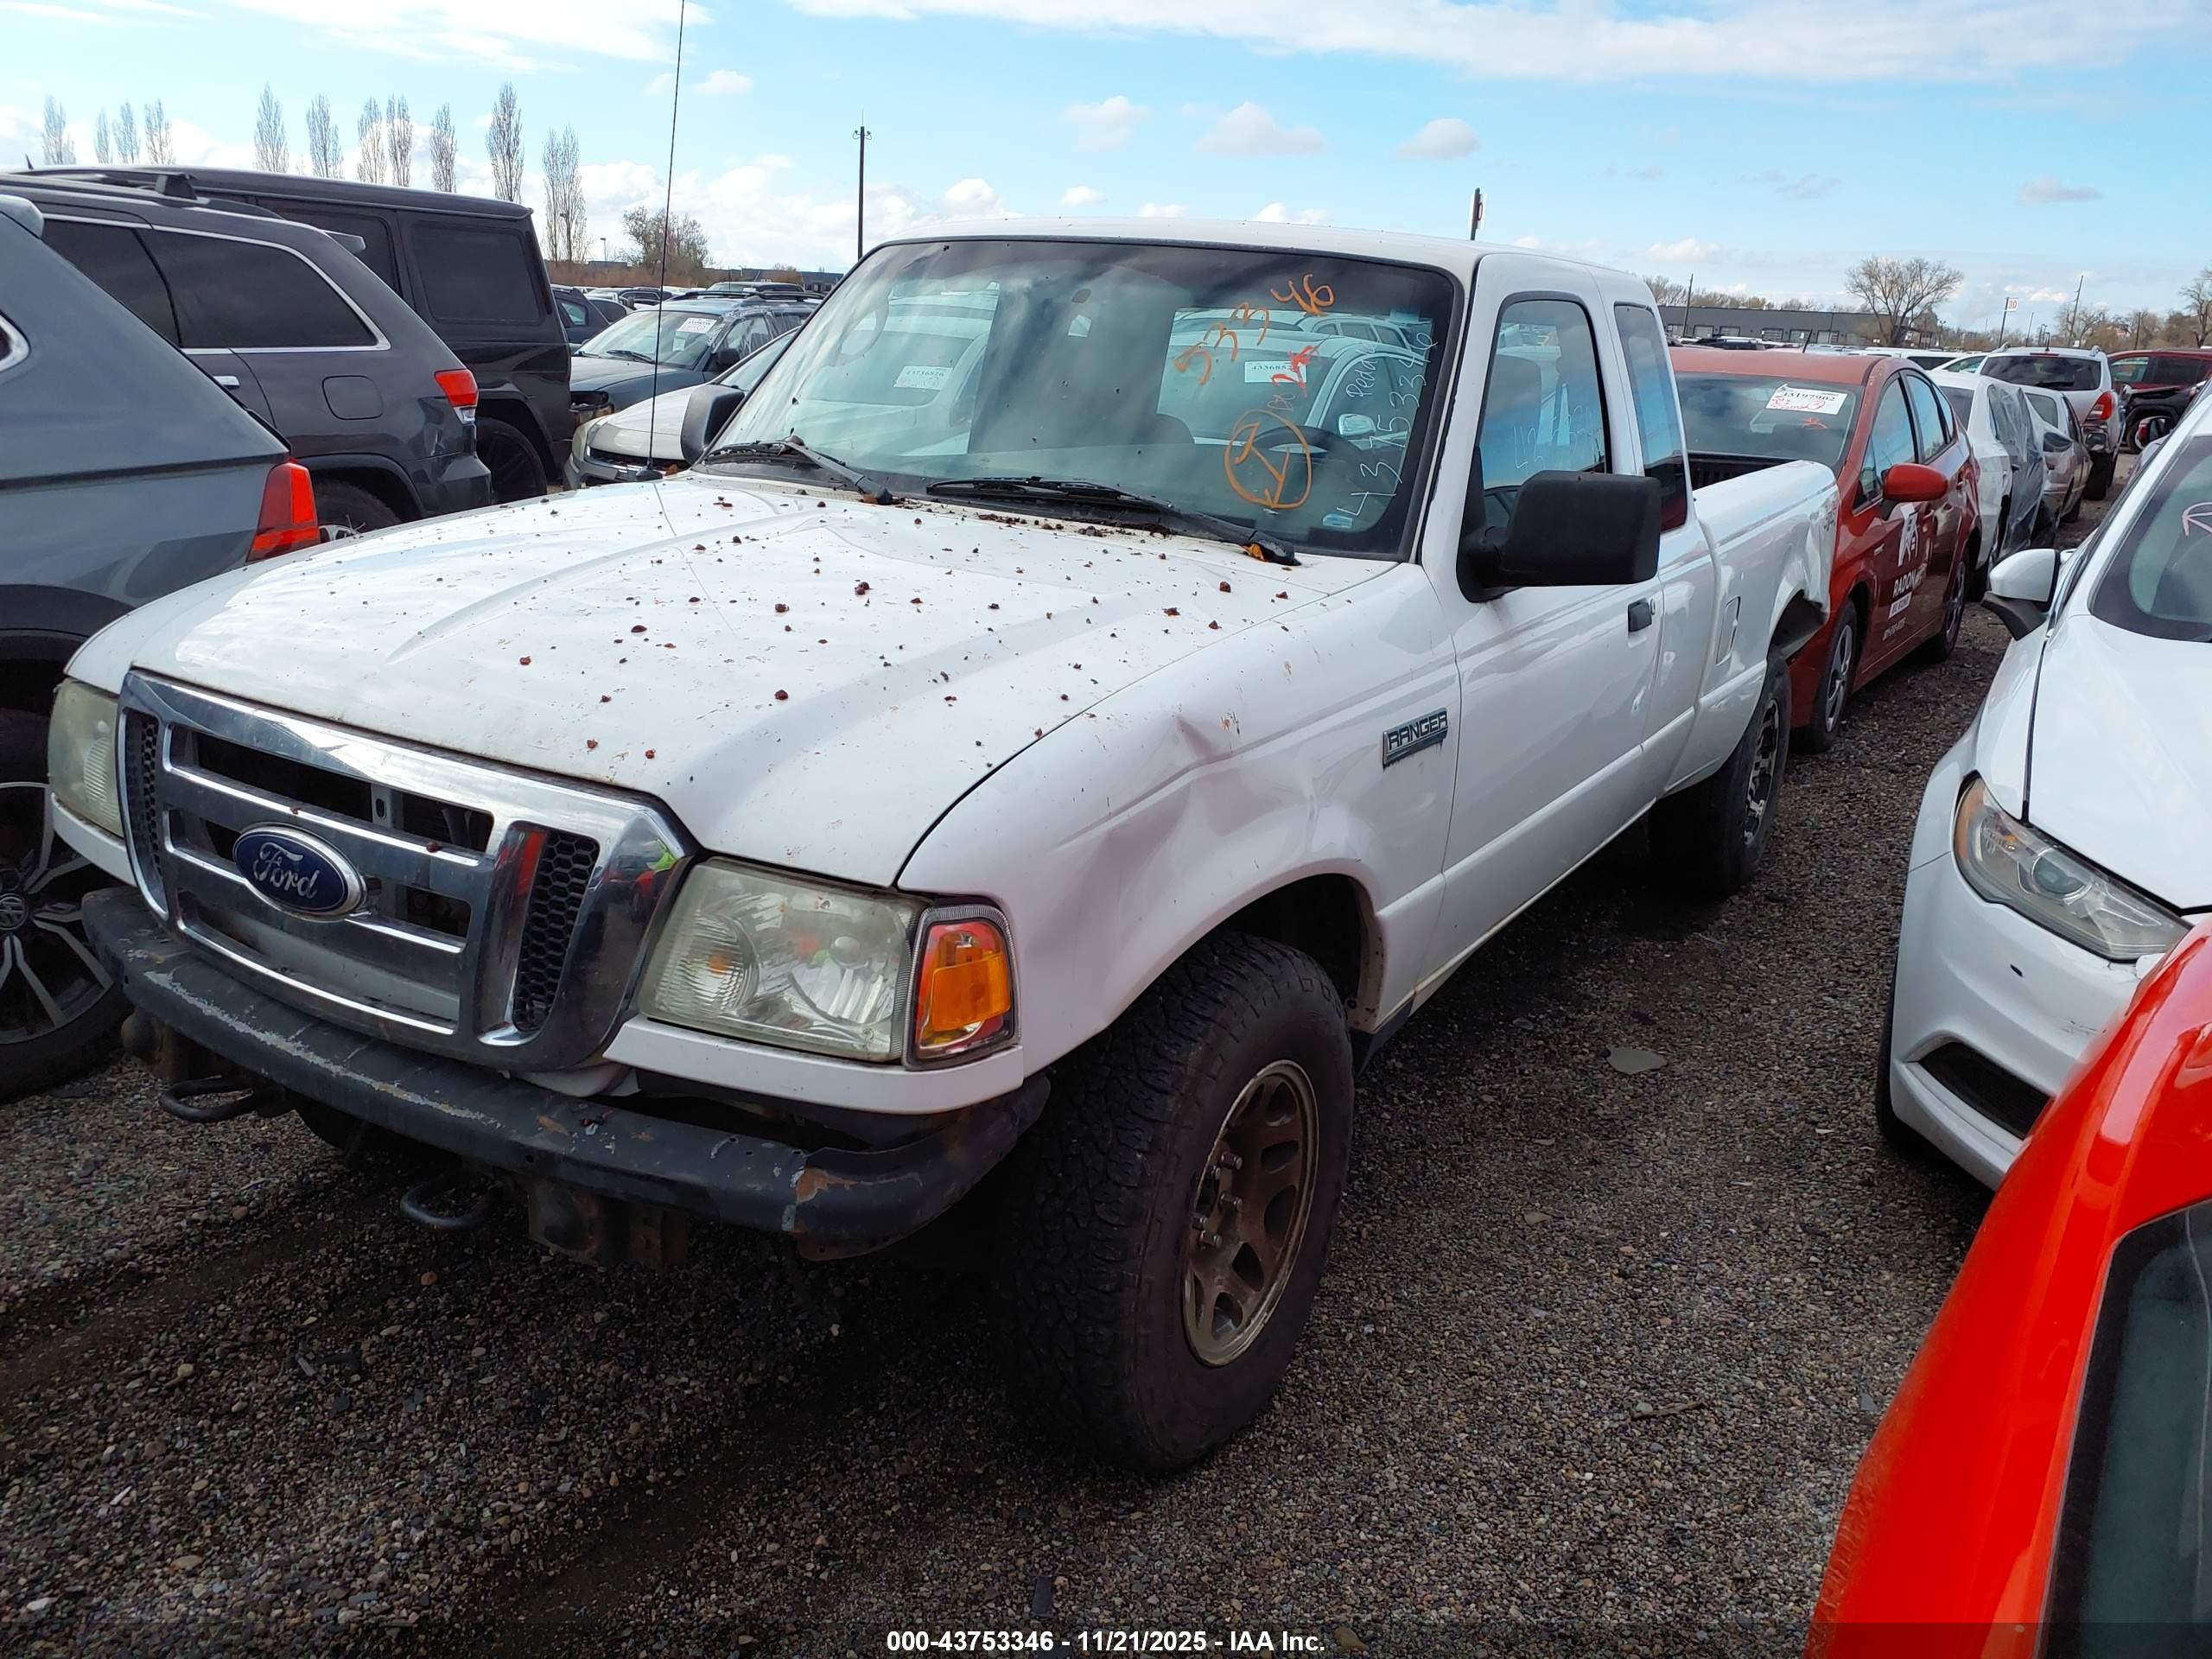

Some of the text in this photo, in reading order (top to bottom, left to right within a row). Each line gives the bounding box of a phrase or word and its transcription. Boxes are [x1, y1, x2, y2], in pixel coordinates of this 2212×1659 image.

[1337, 332, 1439, 517] 43753346
[1892, 569, 1916, 597] RADON
[1388, 710, 1448, 750] RANGER
[252, 842, 321, 899] Ford
